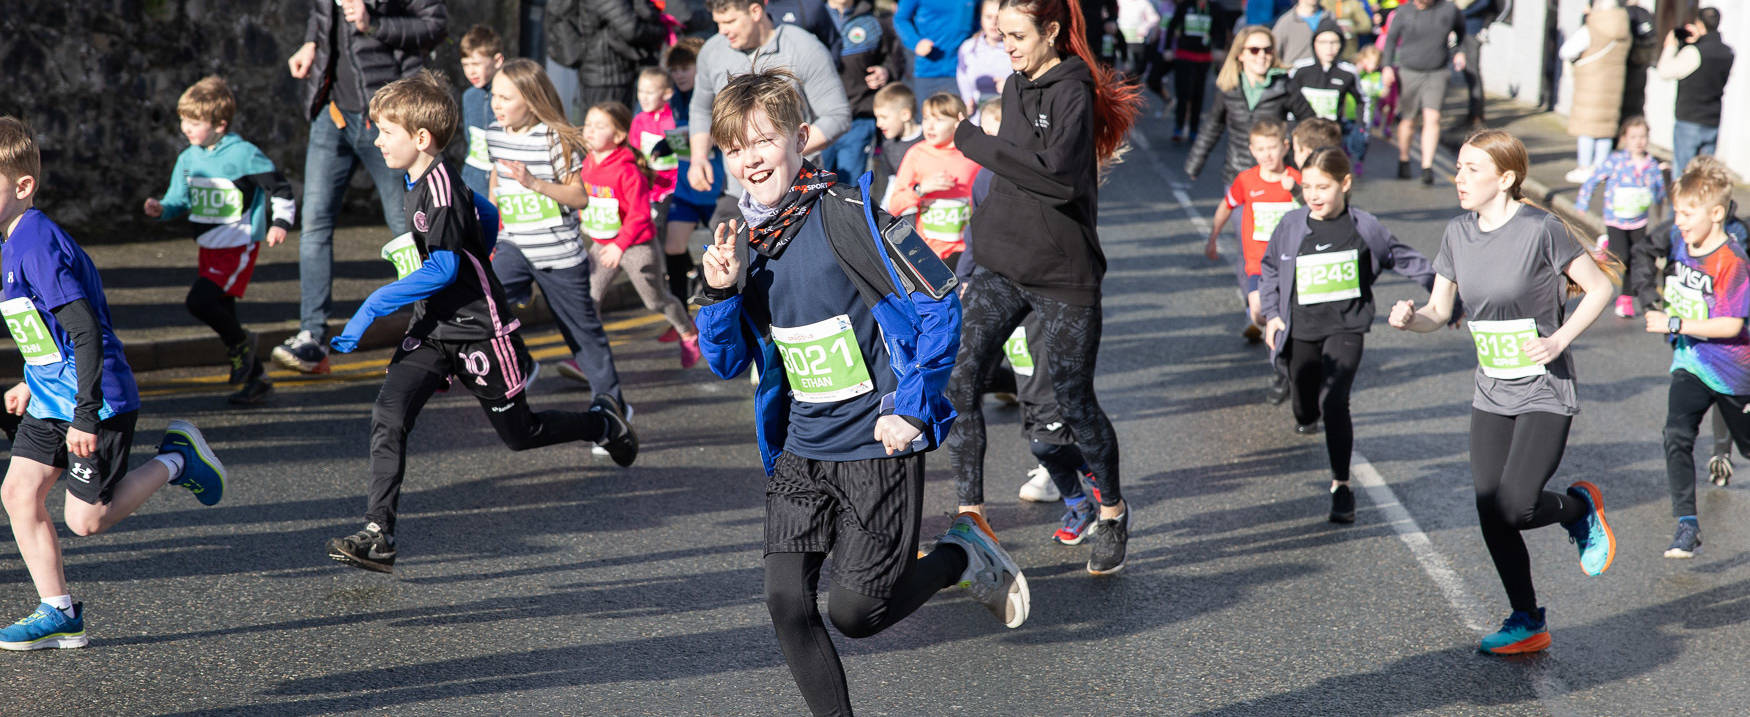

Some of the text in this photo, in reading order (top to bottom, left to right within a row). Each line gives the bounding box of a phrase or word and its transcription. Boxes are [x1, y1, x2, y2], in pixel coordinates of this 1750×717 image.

[192, 188, 239, 209] 3104
[1297, 261, 1357, 288] 3243
[459, 350, 490, 376] 10
[778, 336, 854, 377] 3021
[801, 376, 833, 389] ETHAN
